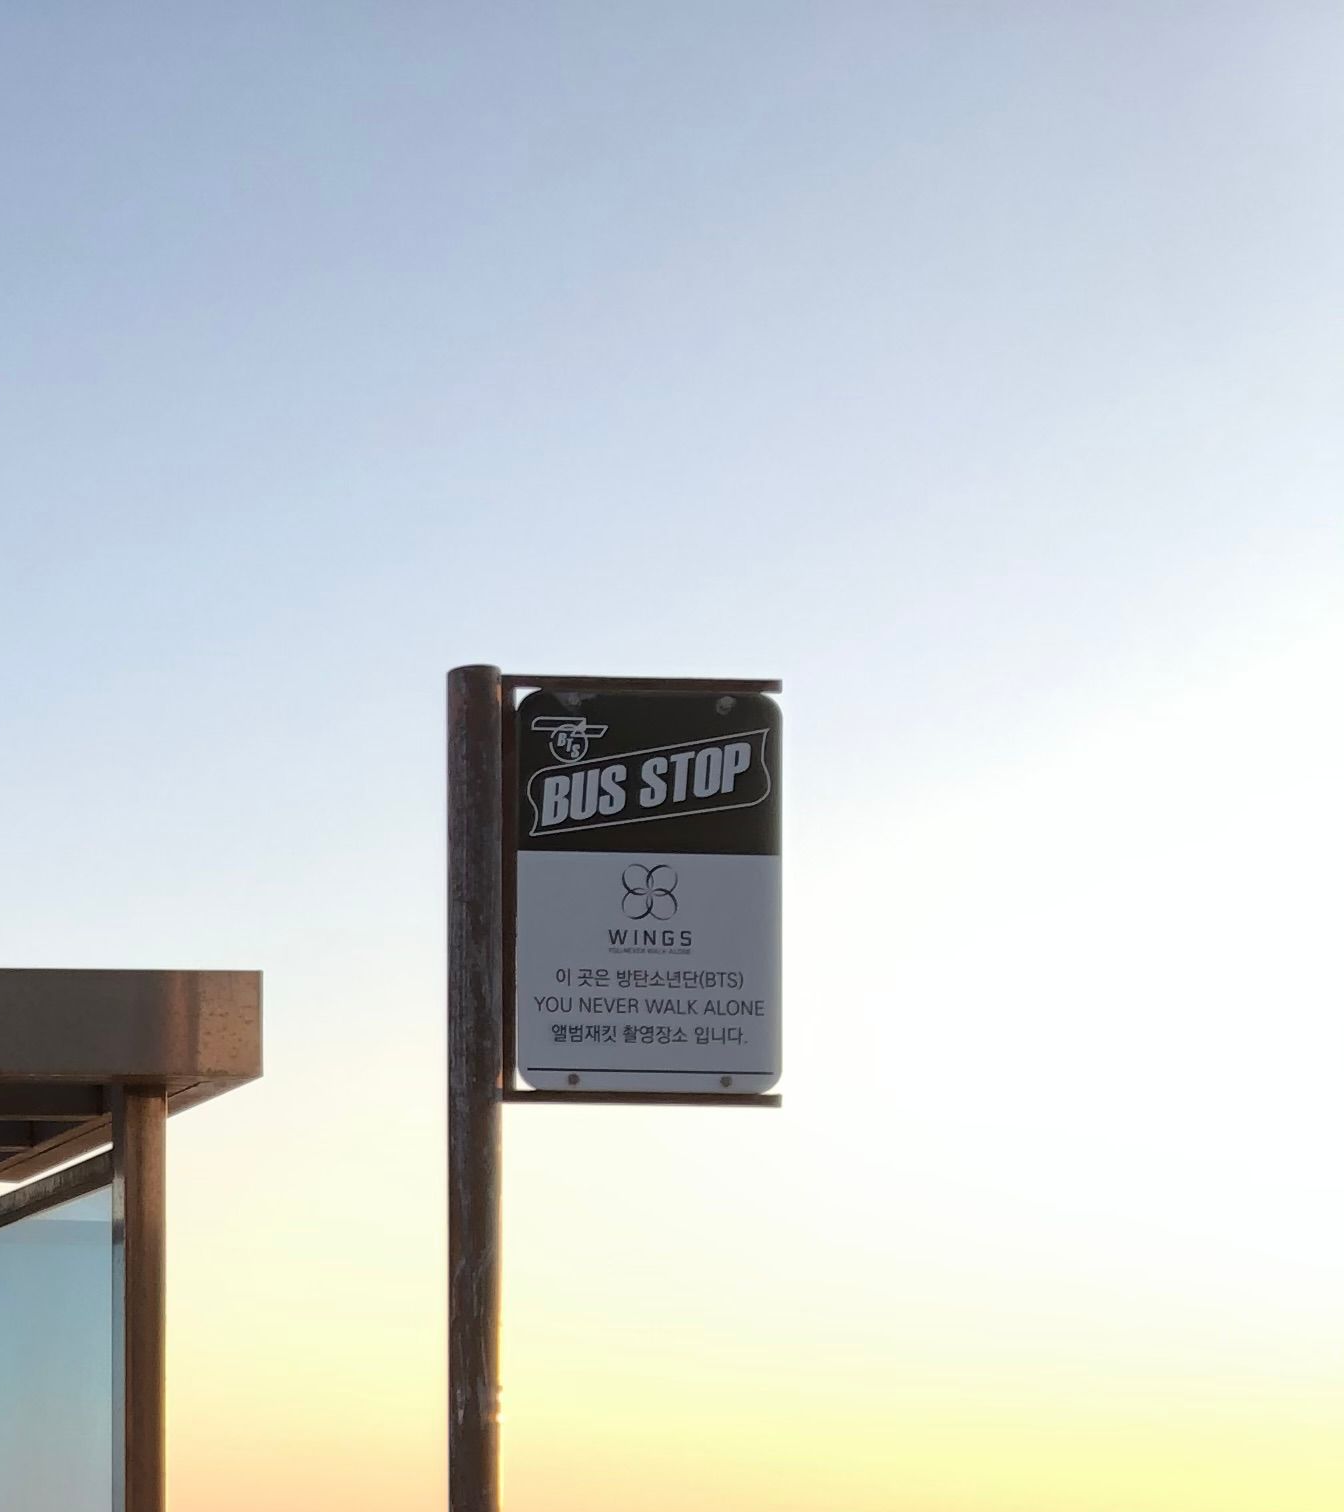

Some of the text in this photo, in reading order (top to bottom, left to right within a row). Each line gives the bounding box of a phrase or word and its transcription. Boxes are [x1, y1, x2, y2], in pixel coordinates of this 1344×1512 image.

[556, 732, 581, 759] BTS
[541, 742, 752, 827] BUS STOP
[608, 929, 692, 946] WINGS
[555, 968, 744, 989] 이 곳은 방탄소년단(BTS)
[534, 996, 765, 1017] YOU NEVER WALK ALONE
[551, 1024, 748, 1045] 앨범재킷 촬영장소 입니다.
